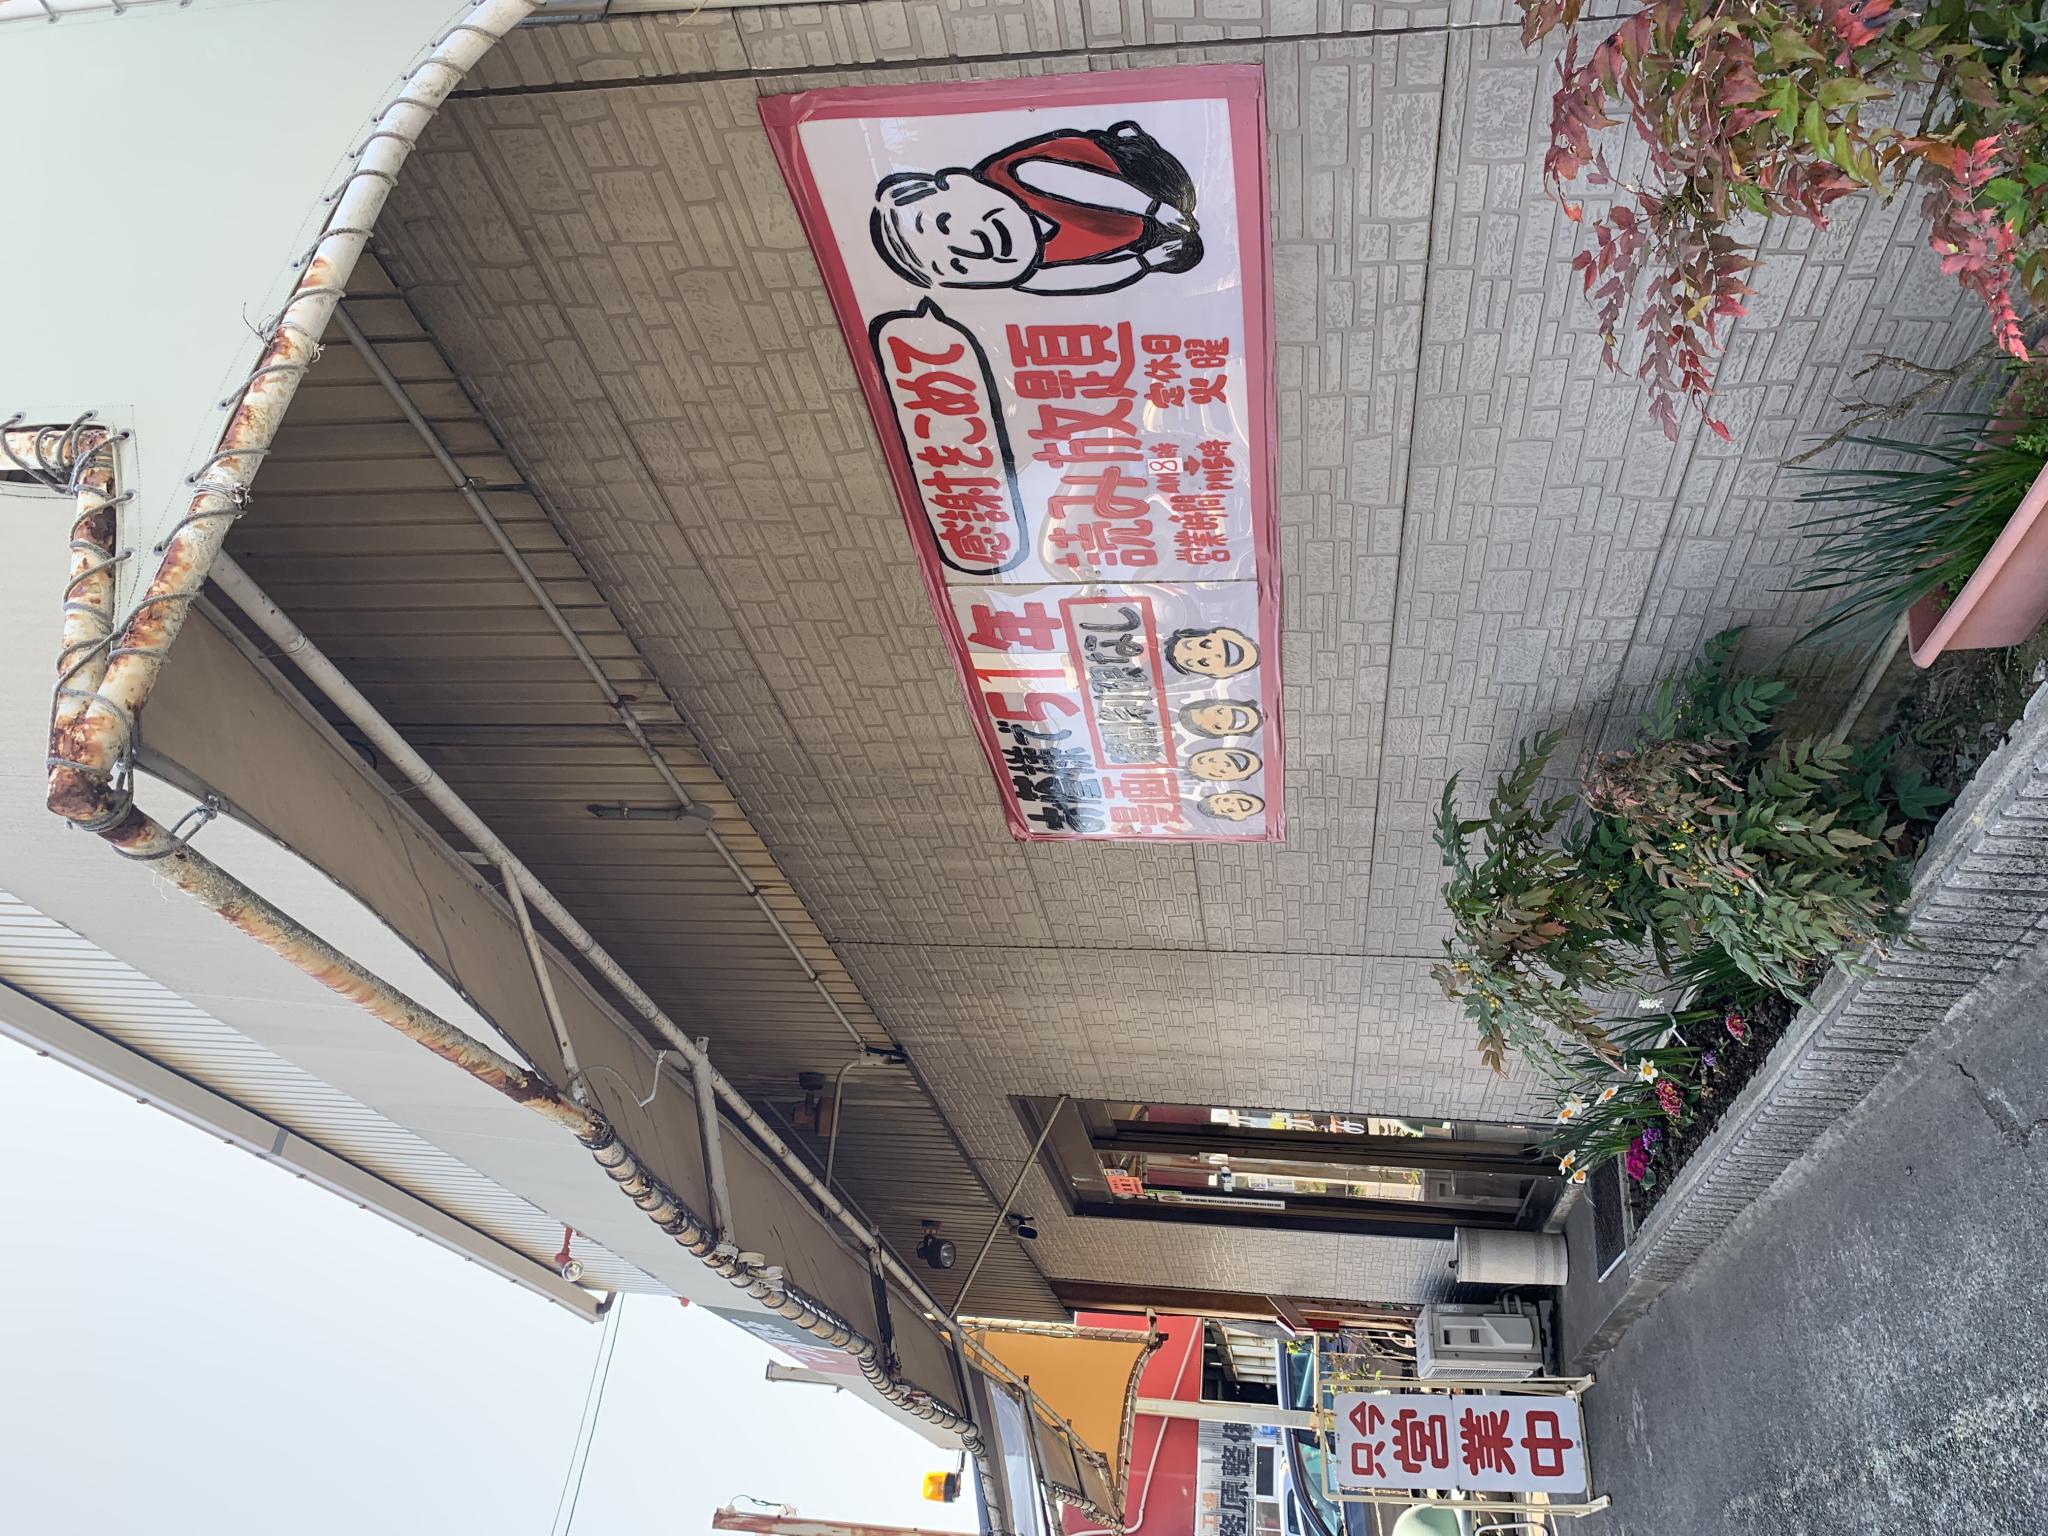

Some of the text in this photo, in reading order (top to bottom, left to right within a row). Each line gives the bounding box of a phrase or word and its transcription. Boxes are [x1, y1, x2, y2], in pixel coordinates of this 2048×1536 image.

[1140, 334, 1186, 409] 定休日
[1183, 336, 1231, 405] 火曜
[886, 335, 1012, 565] 感謝をこめて
[1004, 321, 1158, 568] 読み放題
[1168, 493, 1232, 565] 営業時間
[1101, 772, 1185, 834] 漫画
